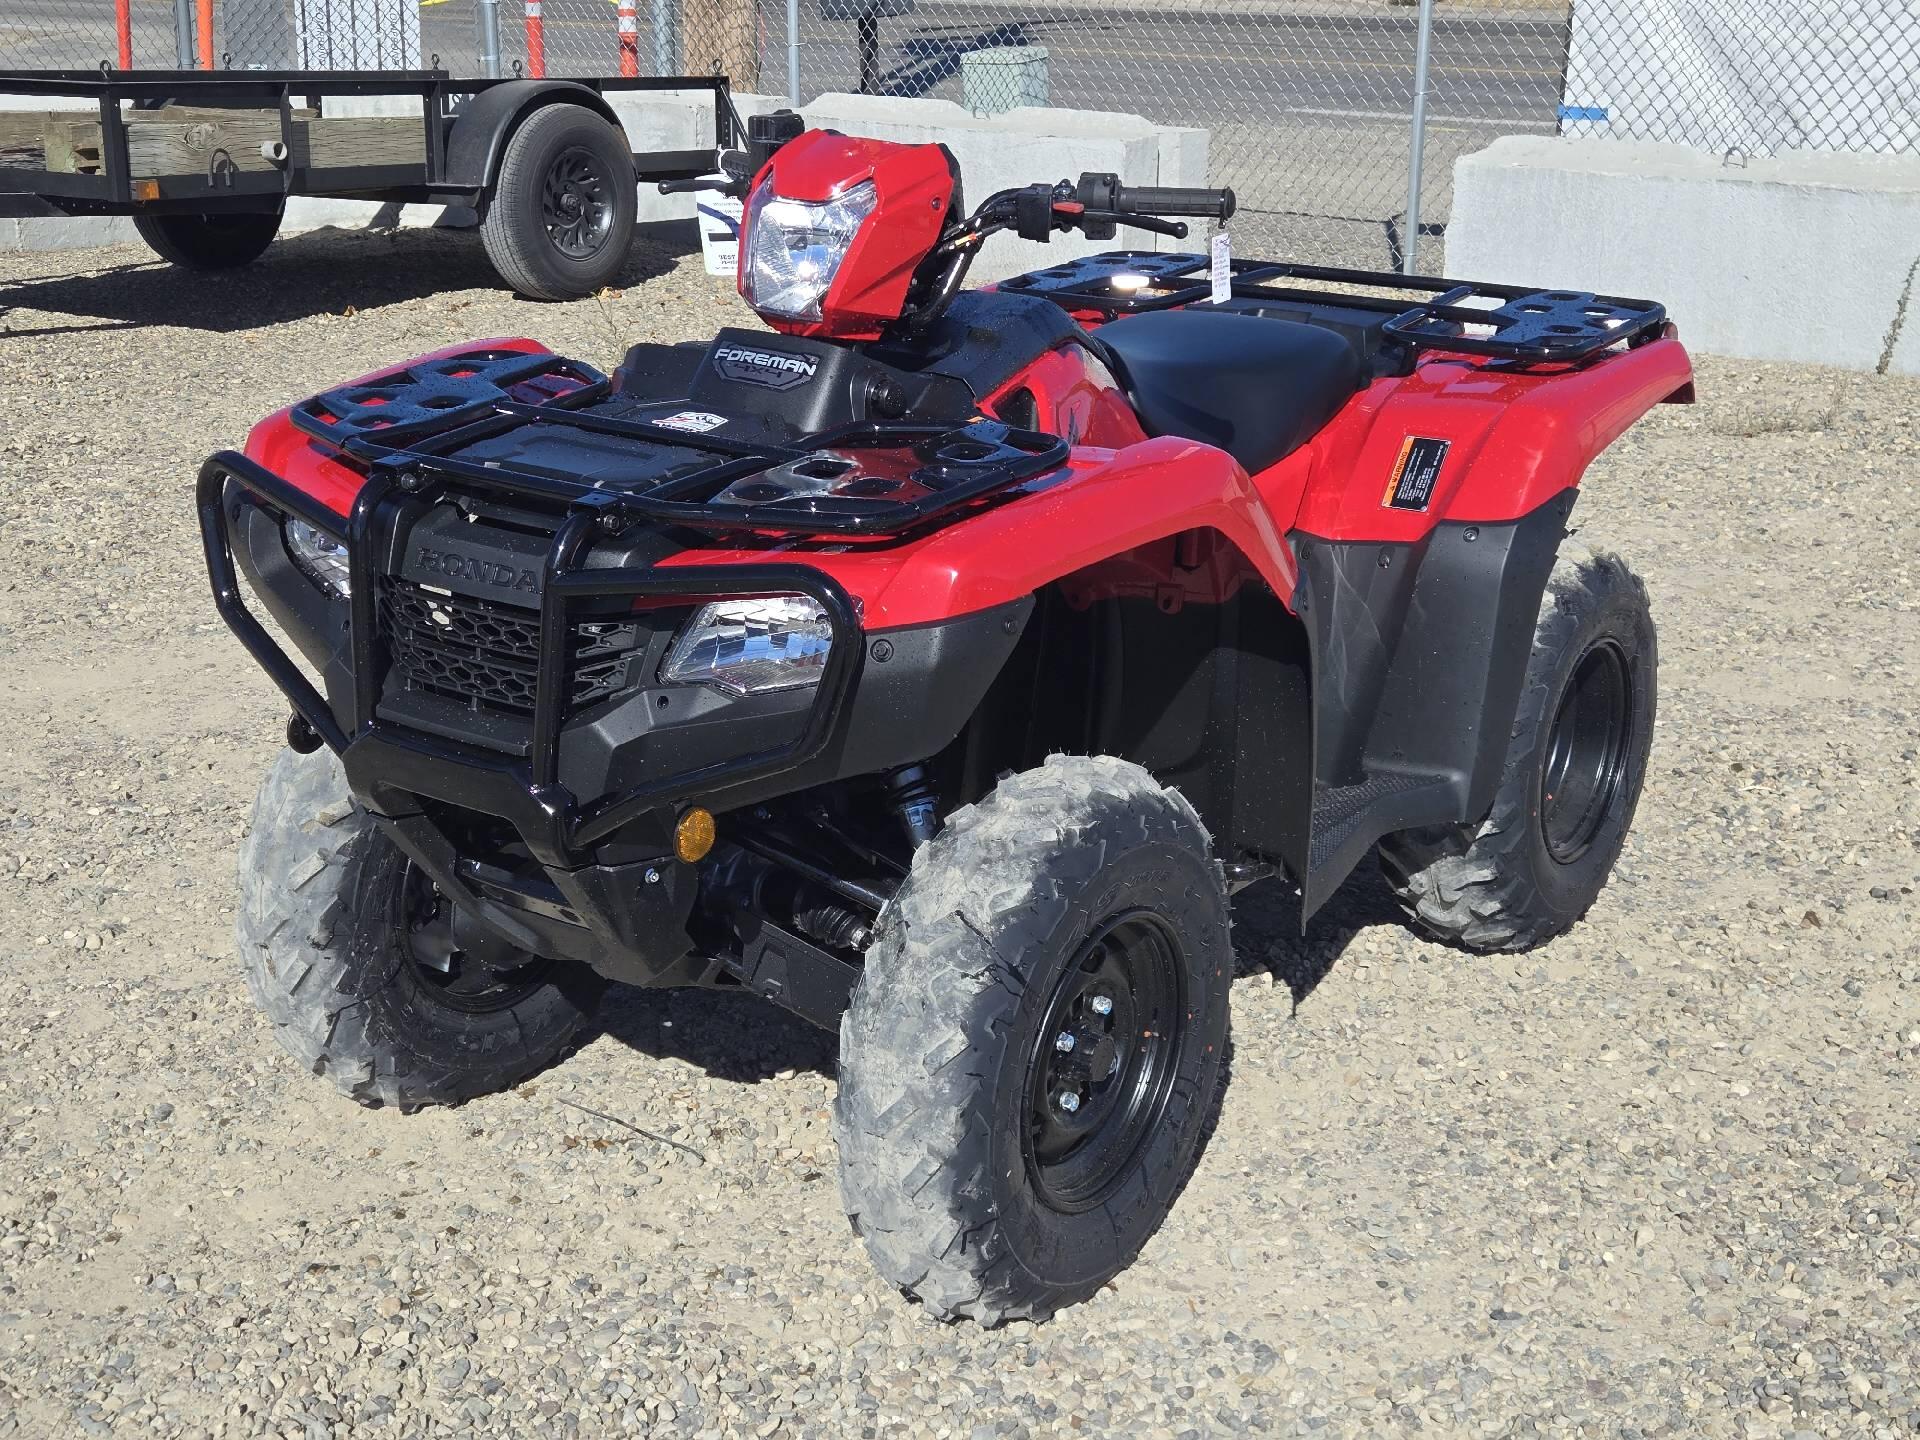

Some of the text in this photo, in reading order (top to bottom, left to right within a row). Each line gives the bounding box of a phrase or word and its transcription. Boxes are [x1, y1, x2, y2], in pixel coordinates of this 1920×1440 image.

[714, 348, 817, 376] FOREMAN
[1392, 451, 1408, 482] WARNING
[415, 547, 542, 595] HONDA
